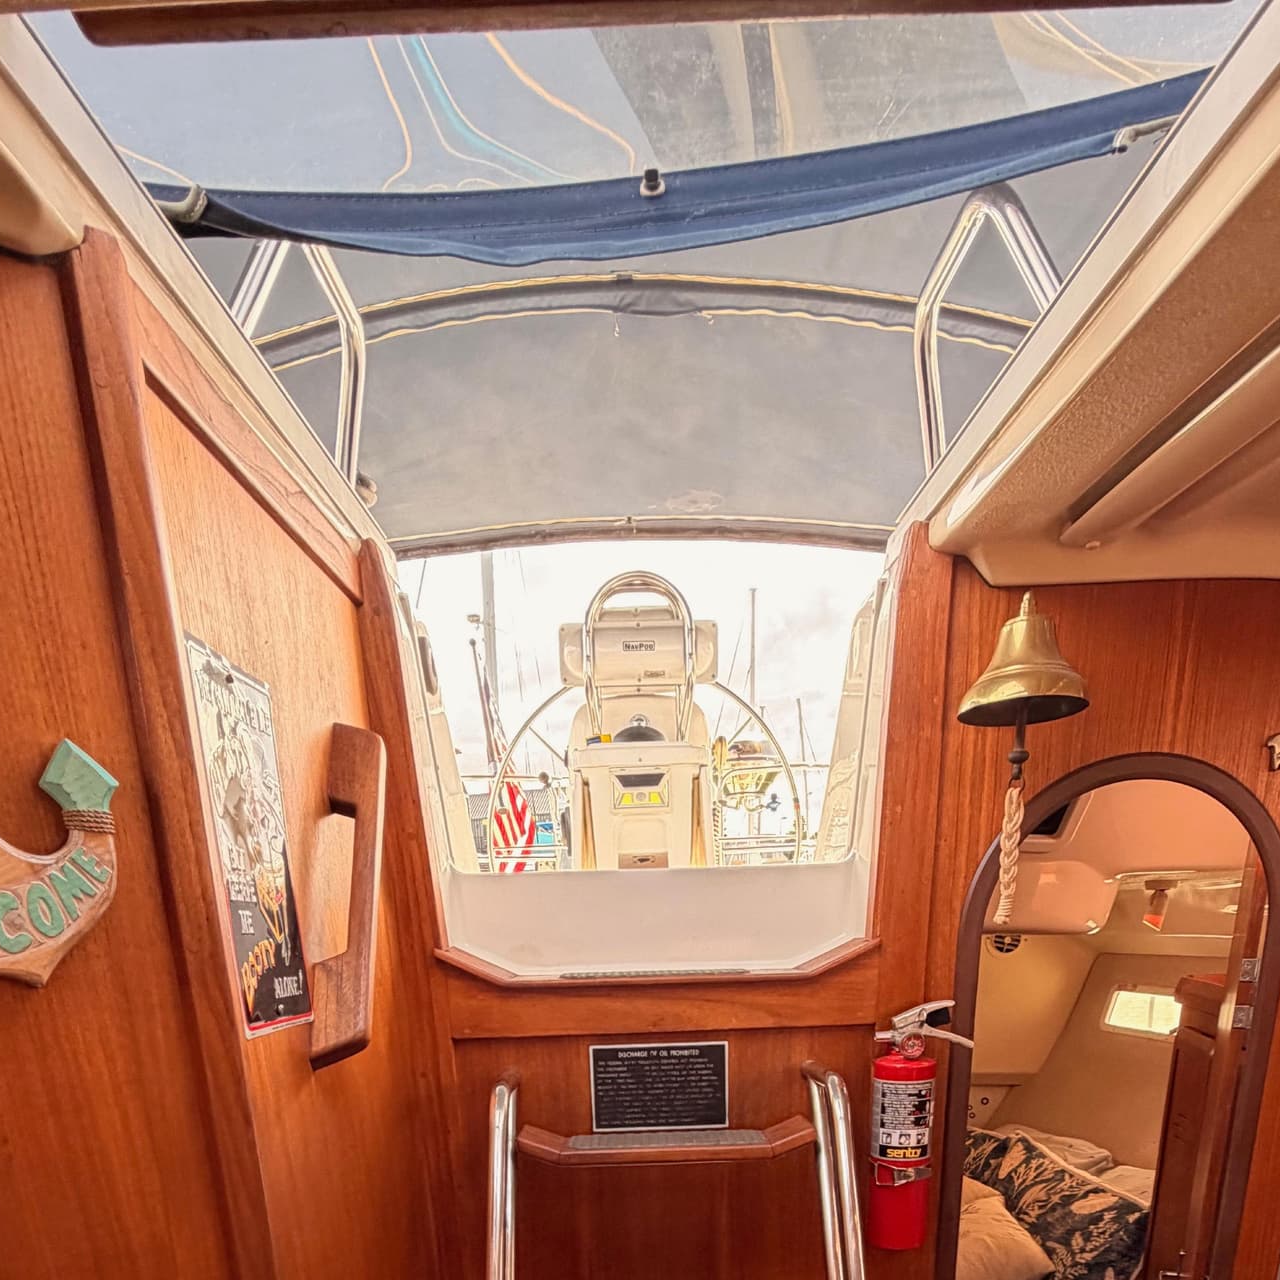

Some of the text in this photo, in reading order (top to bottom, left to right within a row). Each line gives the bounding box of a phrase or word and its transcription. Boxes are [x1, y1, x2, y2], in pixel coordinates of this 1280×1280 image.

[238, 909, 255, 934] ME
[241, 938, 276, 1014] BOOTY
[273, 969, 303, 999] ALONE!
